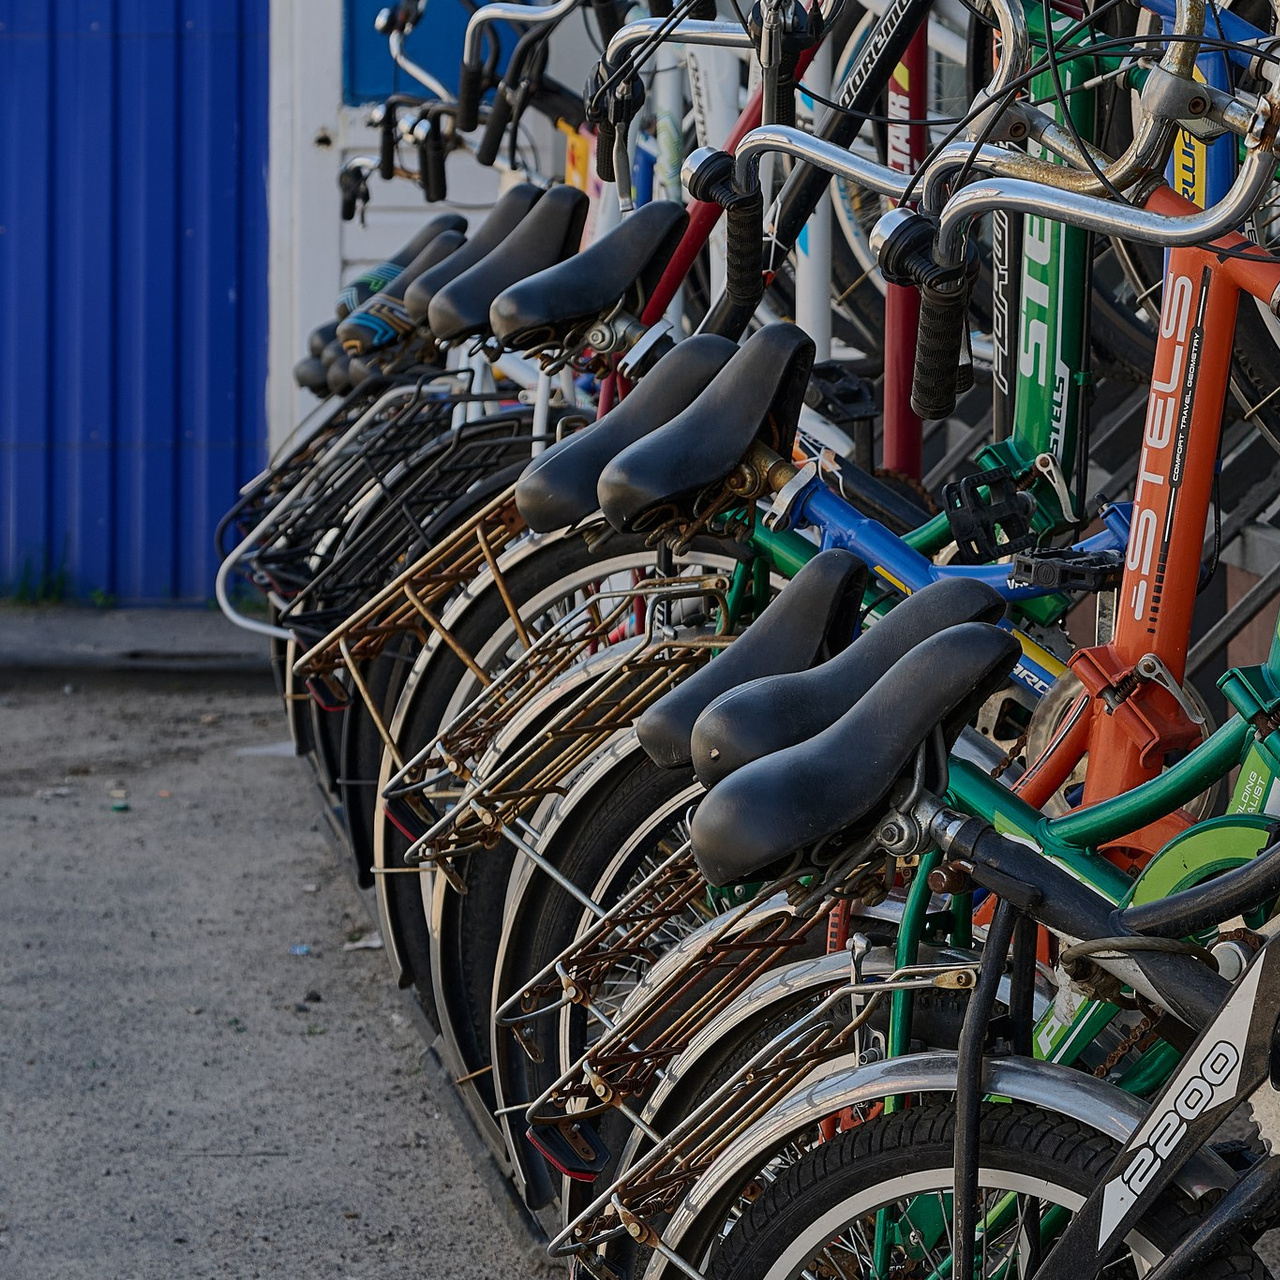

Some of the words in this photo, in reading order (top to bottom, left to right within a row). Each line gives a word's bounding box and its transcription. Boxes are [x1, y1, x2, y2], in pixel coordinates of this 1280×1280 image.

[887, 91, 911, 175] LTAIR
[992, 209, 1009, 396] FORW
[1126, 272, 1194, 576] STELS
[1171, 431, 1186, 482] COMFORT
[1179, 389, 1193, 431] TRAVEL
[1186, 331, 1202, 389] GEOMETRY
[1121, 1040, 1240, 1200] 2200
